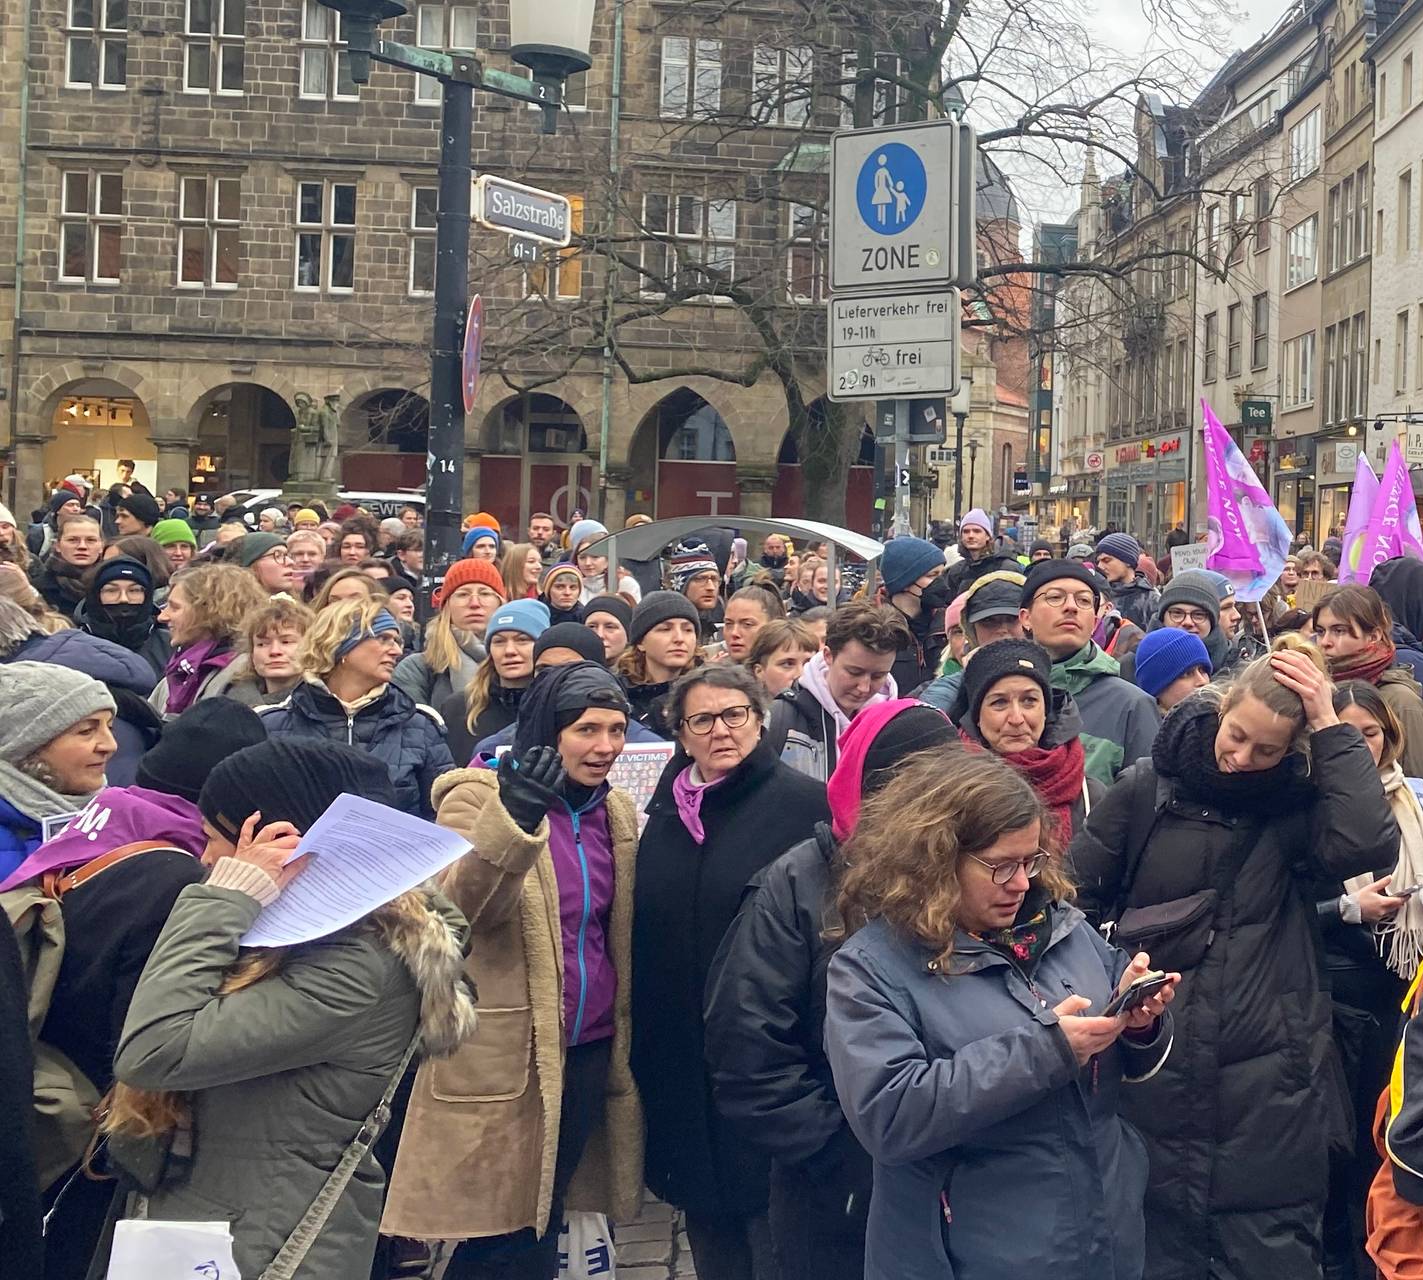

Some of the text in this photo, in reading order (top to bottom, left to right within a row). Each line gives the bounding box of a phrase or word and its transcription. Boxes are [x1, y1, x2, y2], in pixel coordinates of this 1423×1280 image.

[492, 191, 564, 231] Salzstraße
[861, 244, 920, 272] ZONE
[837, 300, 948, 319] Lieferverkehr frei
[842, 326, 876, 341] 19-11h
[896, 348, 922, 365] frei
[1247, 406, 1266, 418] Tee
[440, 460, 455, 473] 14
[626, 752, 668, 762] VICTIMS
